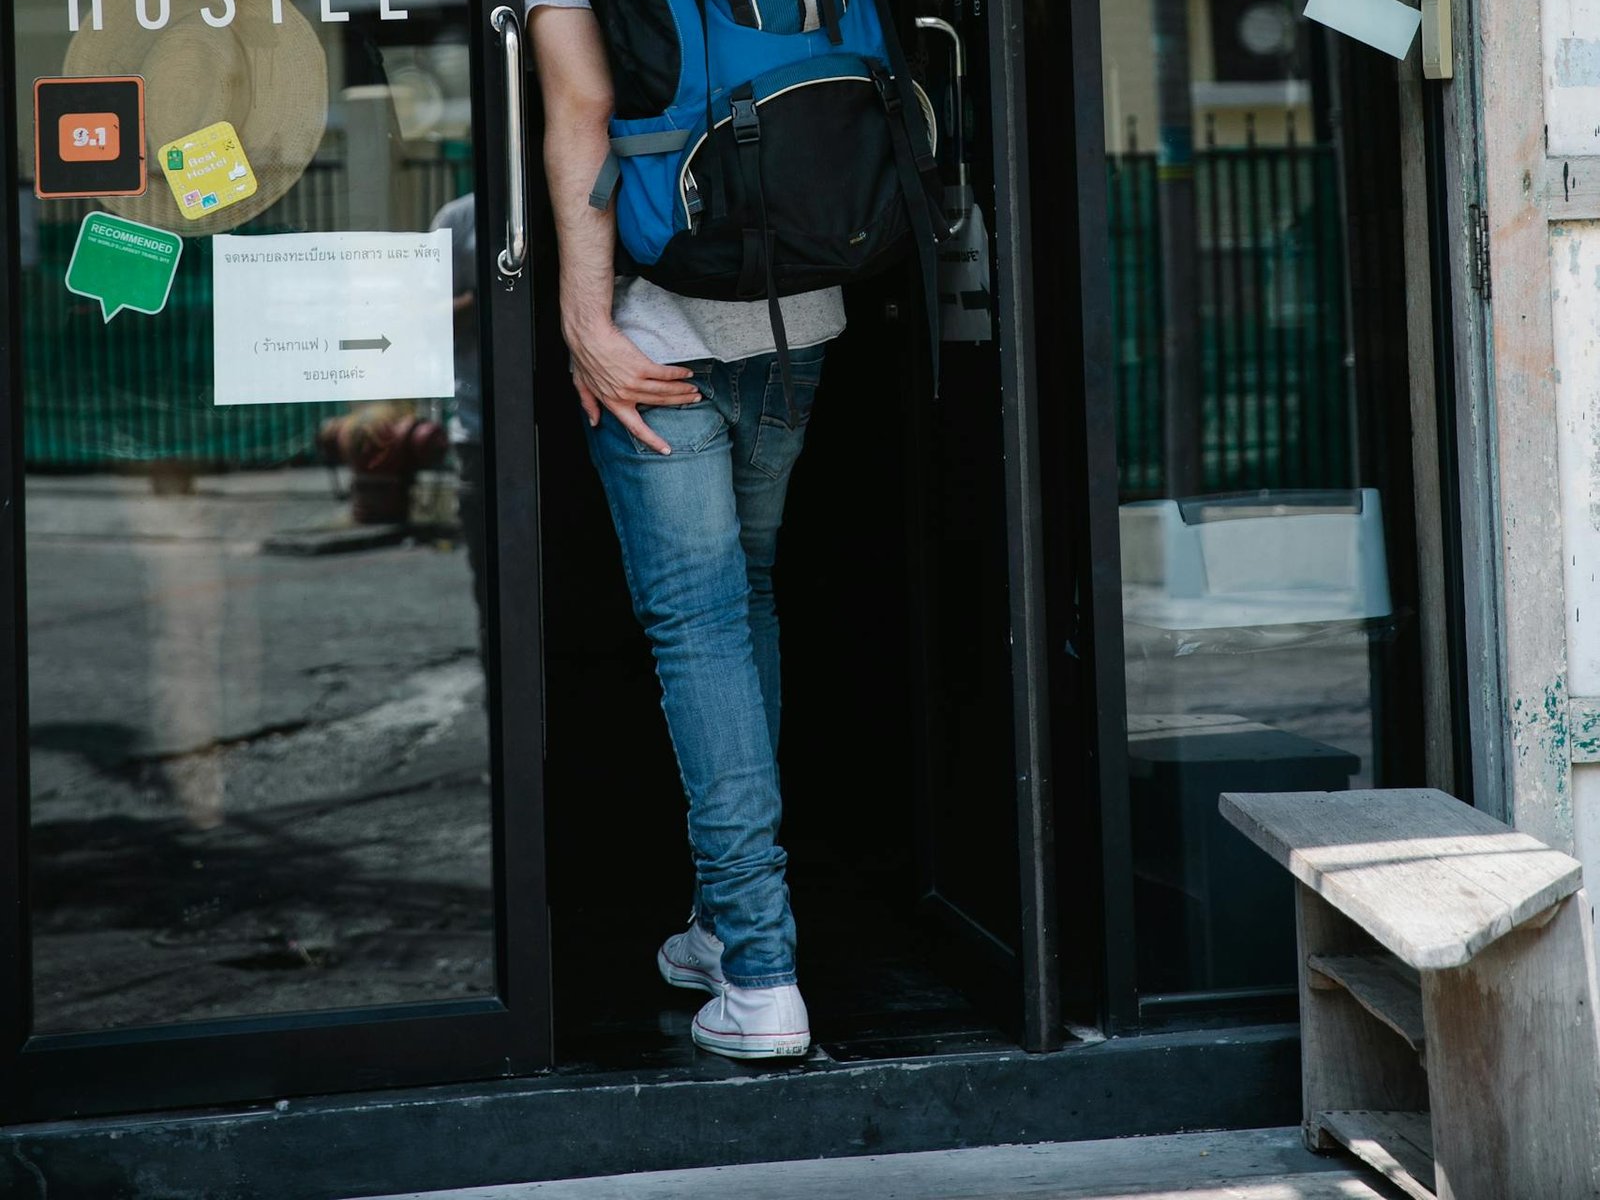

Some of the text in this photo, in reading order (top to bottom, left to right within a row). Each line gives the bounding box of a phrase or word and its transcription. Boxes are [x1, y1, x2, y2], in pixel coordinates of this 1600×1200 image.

[72, 127, 106, 146] 9.1
[187, 150, 217, 168] Best
[187, 157, 228, 181] Hostel
[90, 223, 174, 255] RECOMMENDED
[223, 243, 441, 265] จดหมายลงทะเบียน เอกสาร และ พัสดุ
[303, 365, 366, 385] ขอบคุณค่ะ
